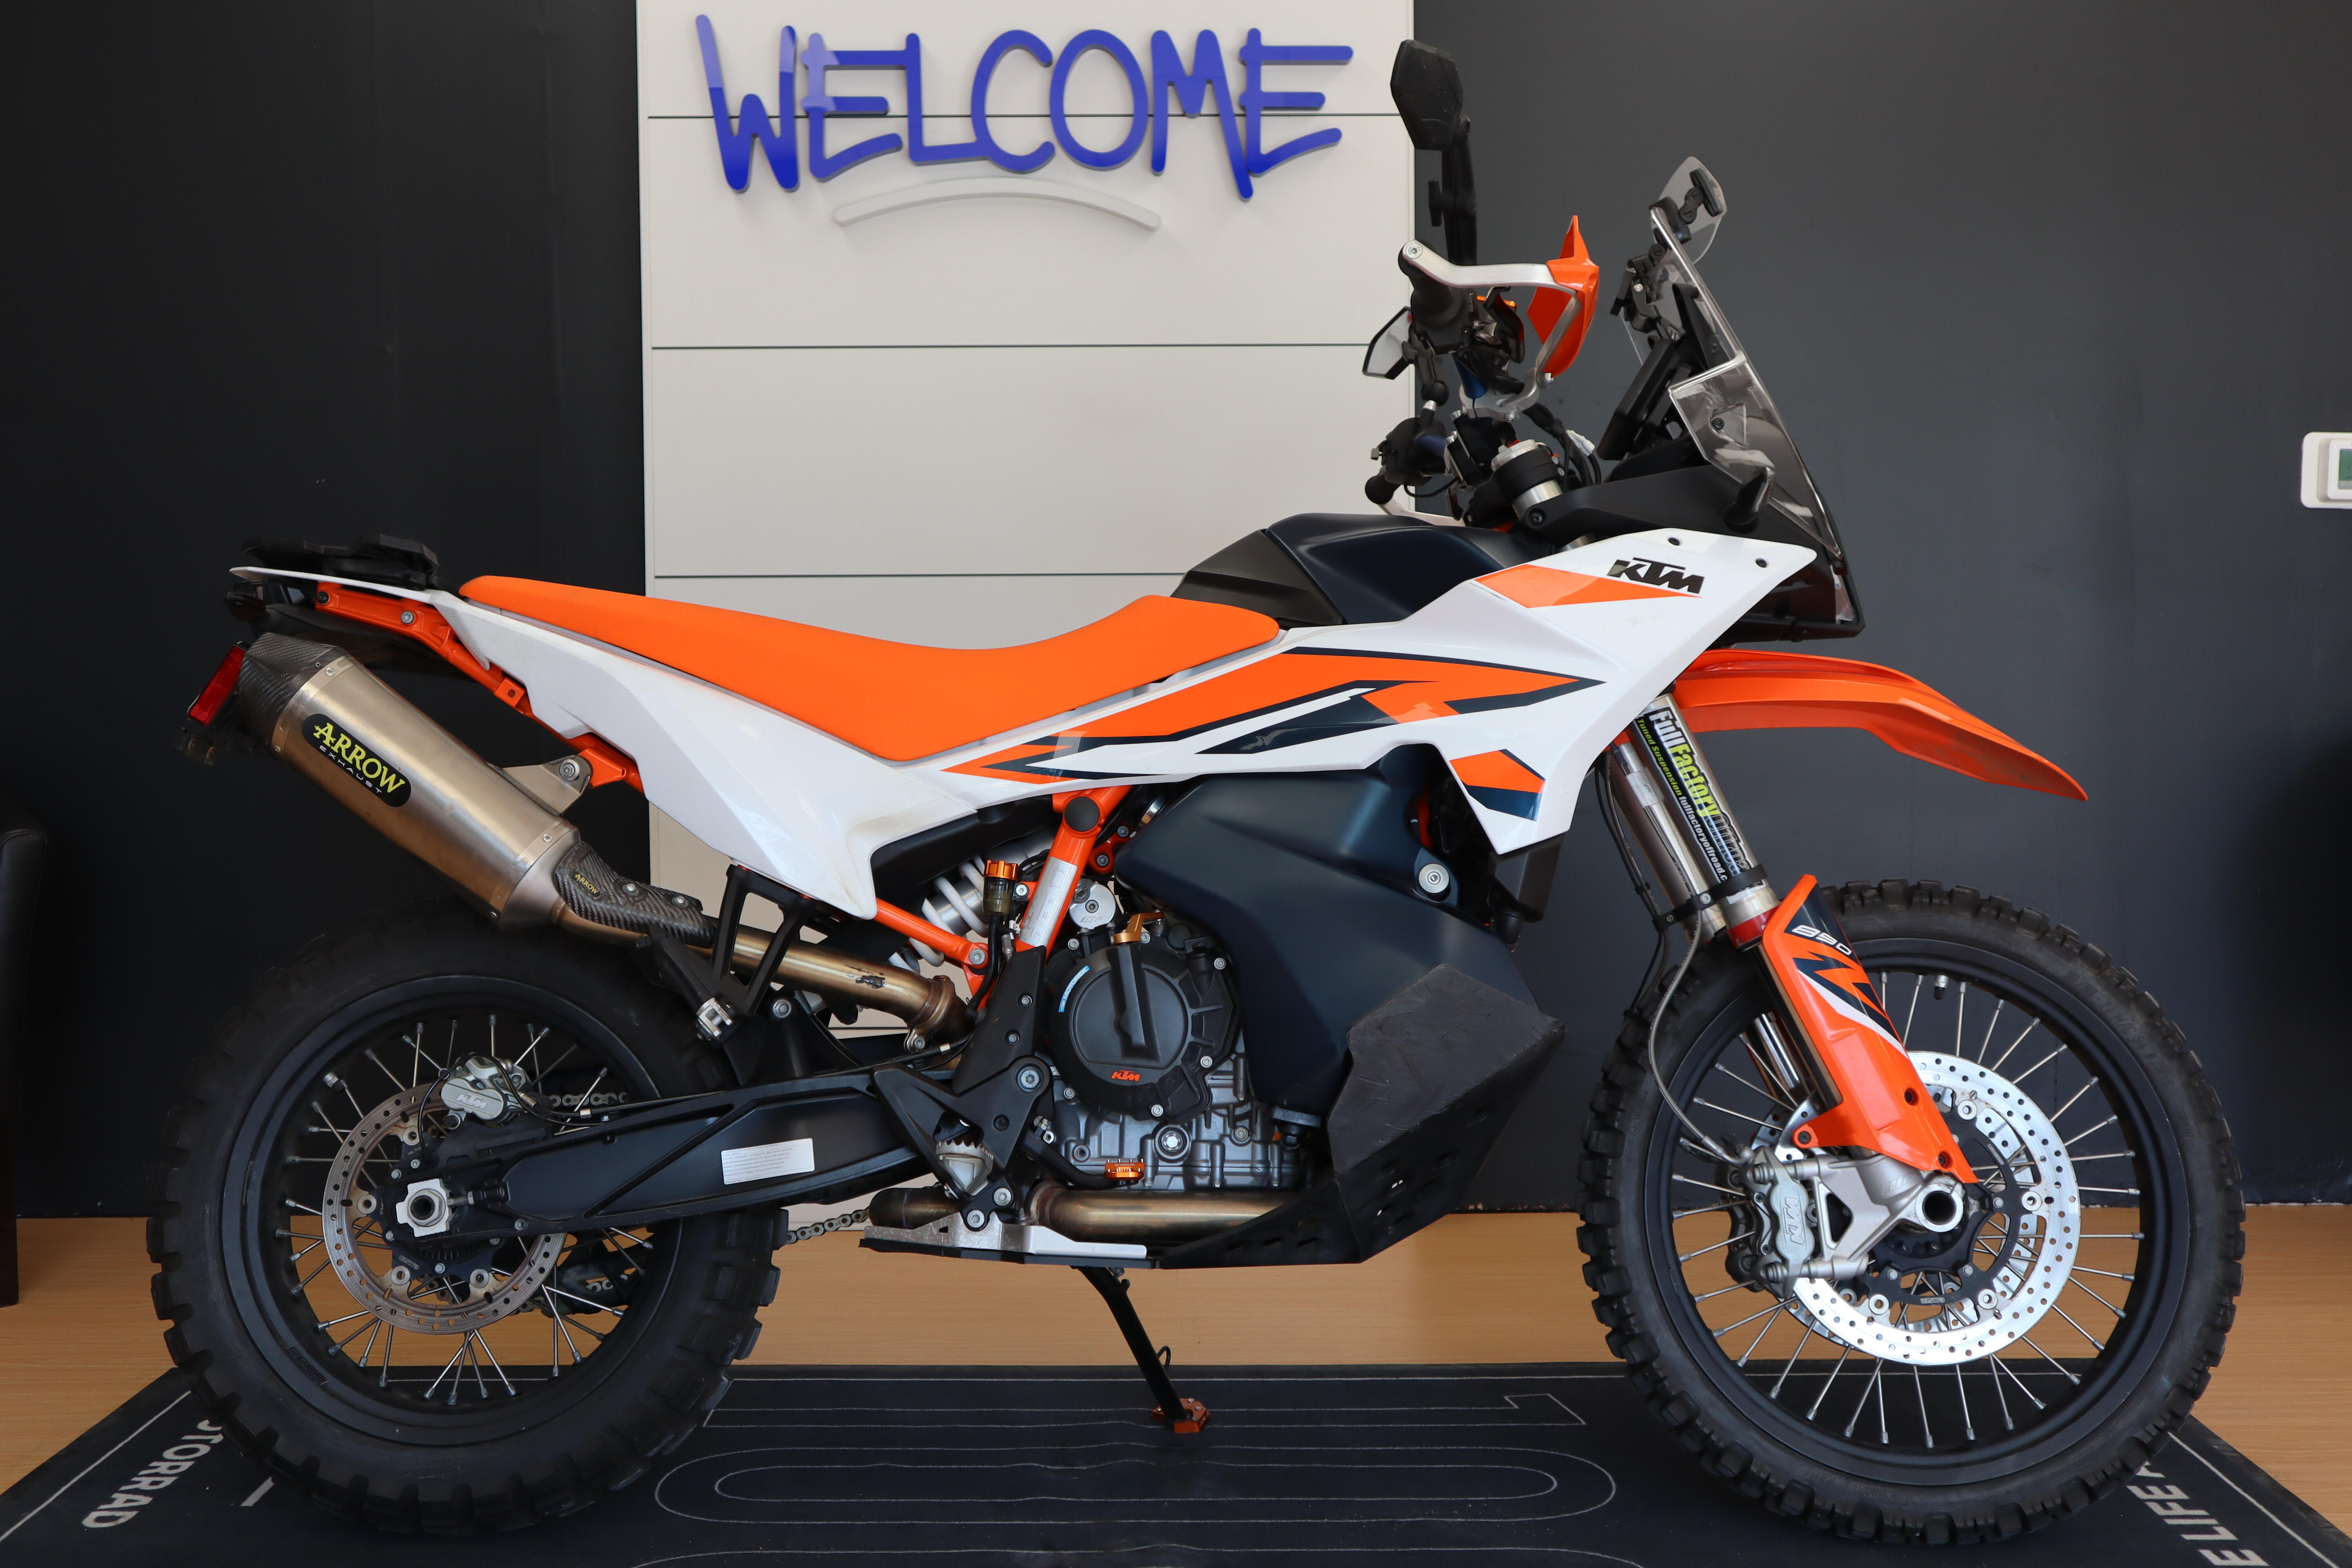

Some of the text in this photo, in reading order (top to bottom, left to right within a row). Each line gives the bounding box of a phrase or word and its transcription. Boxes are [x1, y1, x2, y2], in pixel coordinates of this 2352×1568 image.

[694, 13, 1354, 201] WELCOME
[1606, 557, 1705, 594] KTM
[313, 722, 405, 793] ARROW
[319, 745, 382, 793] EXHAUST
[1636, 719, 1655, 746] Tuned
[1651, 744, 1682, 796] Suspension
[1678, 795, 1729, 883] fullfactoryoffroad.c
[575, 873, 599, 894] ARROW
[1062, 967, 1088, 999] MOTOREX
[1110, 1070, 1141, 1082] KTM
[456, 1093, 488, 1109] KTM
[1785, 1198, 1805, 1245] KTM
[82, 1419, 224, 1528] TORRAD
[2126, 1485, 2238, 1540] LIFE
